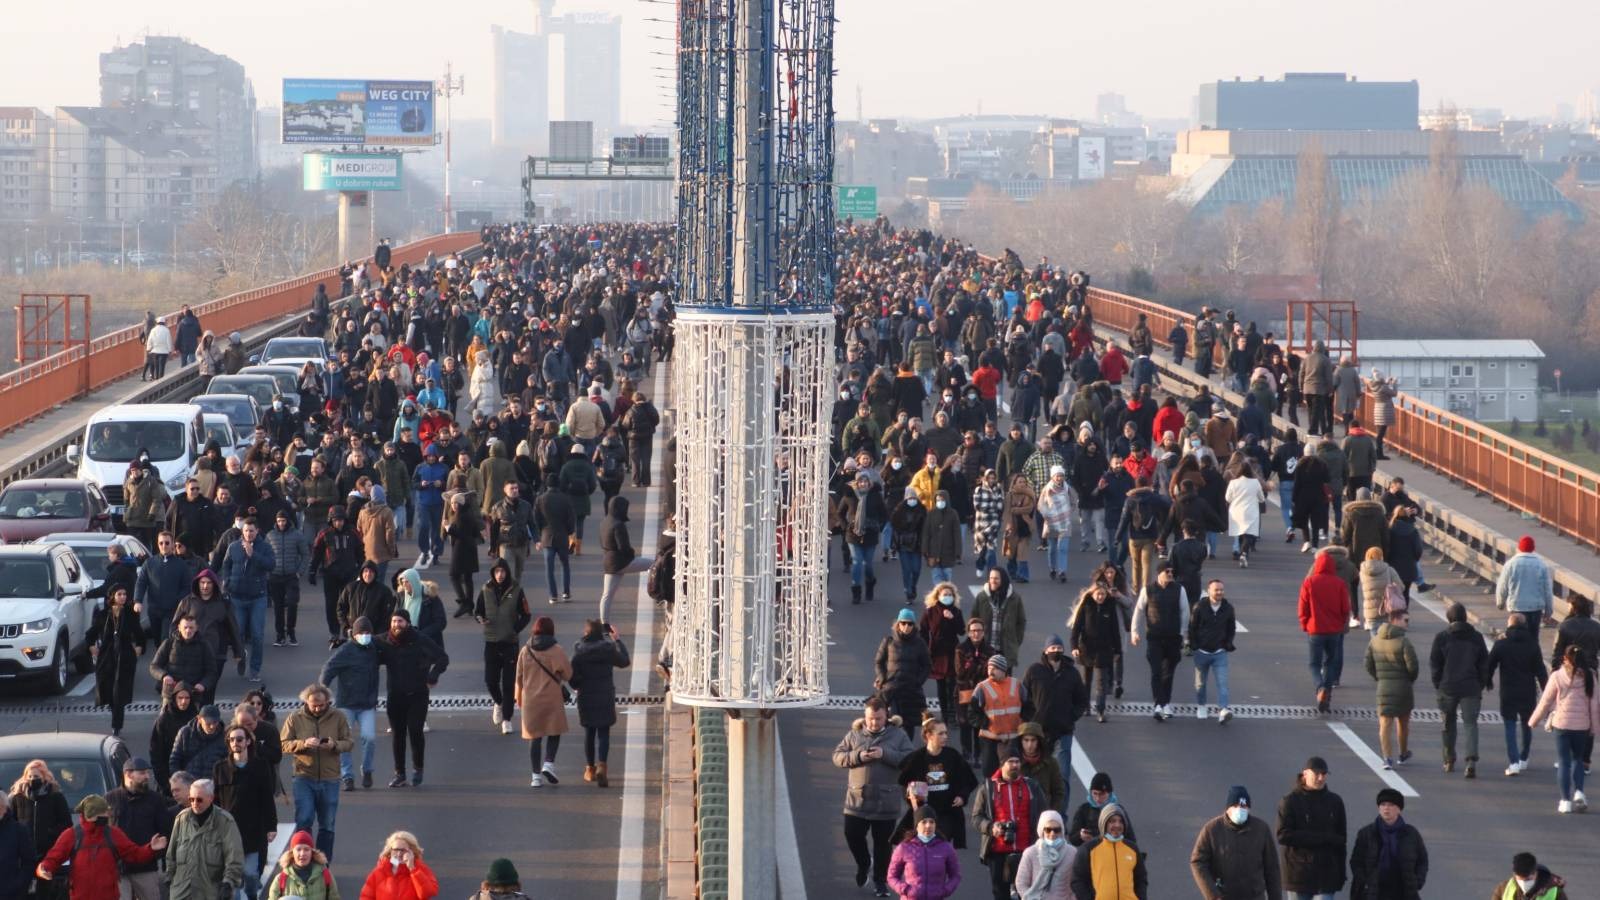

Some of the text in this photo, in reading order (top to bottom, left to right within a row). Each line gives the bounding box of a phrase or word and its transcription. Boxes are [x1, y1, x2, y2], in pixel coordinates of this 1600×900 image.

[369, 90, 398, 100] WEG
[401, 90, 430, 101] CITY
[335, 163, 395, 173] MEDIGROUP
